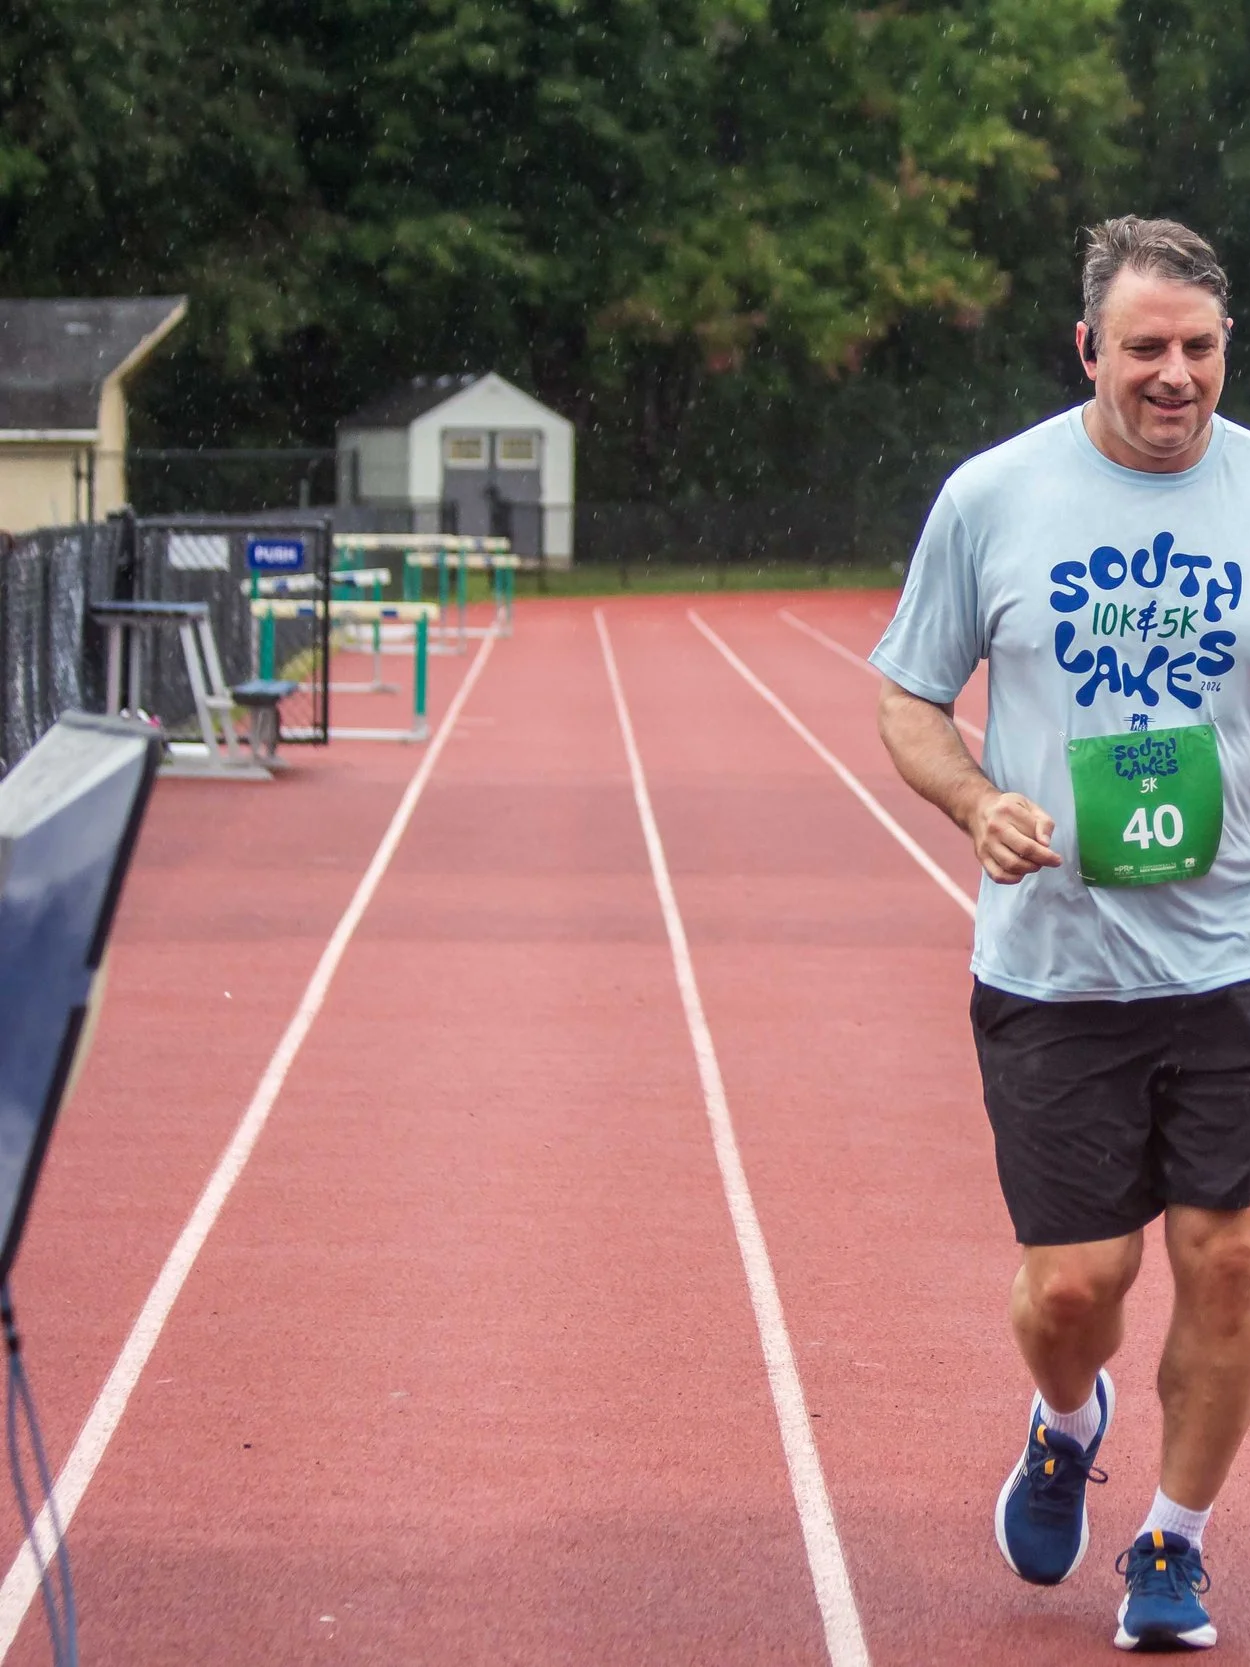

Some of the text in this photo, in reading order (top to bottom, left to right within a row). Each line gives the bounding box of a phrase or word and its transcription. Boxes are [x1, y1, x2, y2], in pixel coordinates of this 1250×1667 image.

[254, 545, 298, 564] PUSH
[1050, 531, 1243, 623] SOUTH
[1092, 602, 1136, 637] 10K
[1157, 606, 1199, 639] 5K
[1054, 620, 1237, 709] LAKES
[1200, 681, 1221, 692] 2026
[1131, 713, 1149, 727] PR
[1114, 737, 1176, 760] SOUTH
[1115, 756, 1179, 780] LAKES
[1140, 777, 1158, 793] 5K
[1123, 804, 1184, 849] 40
